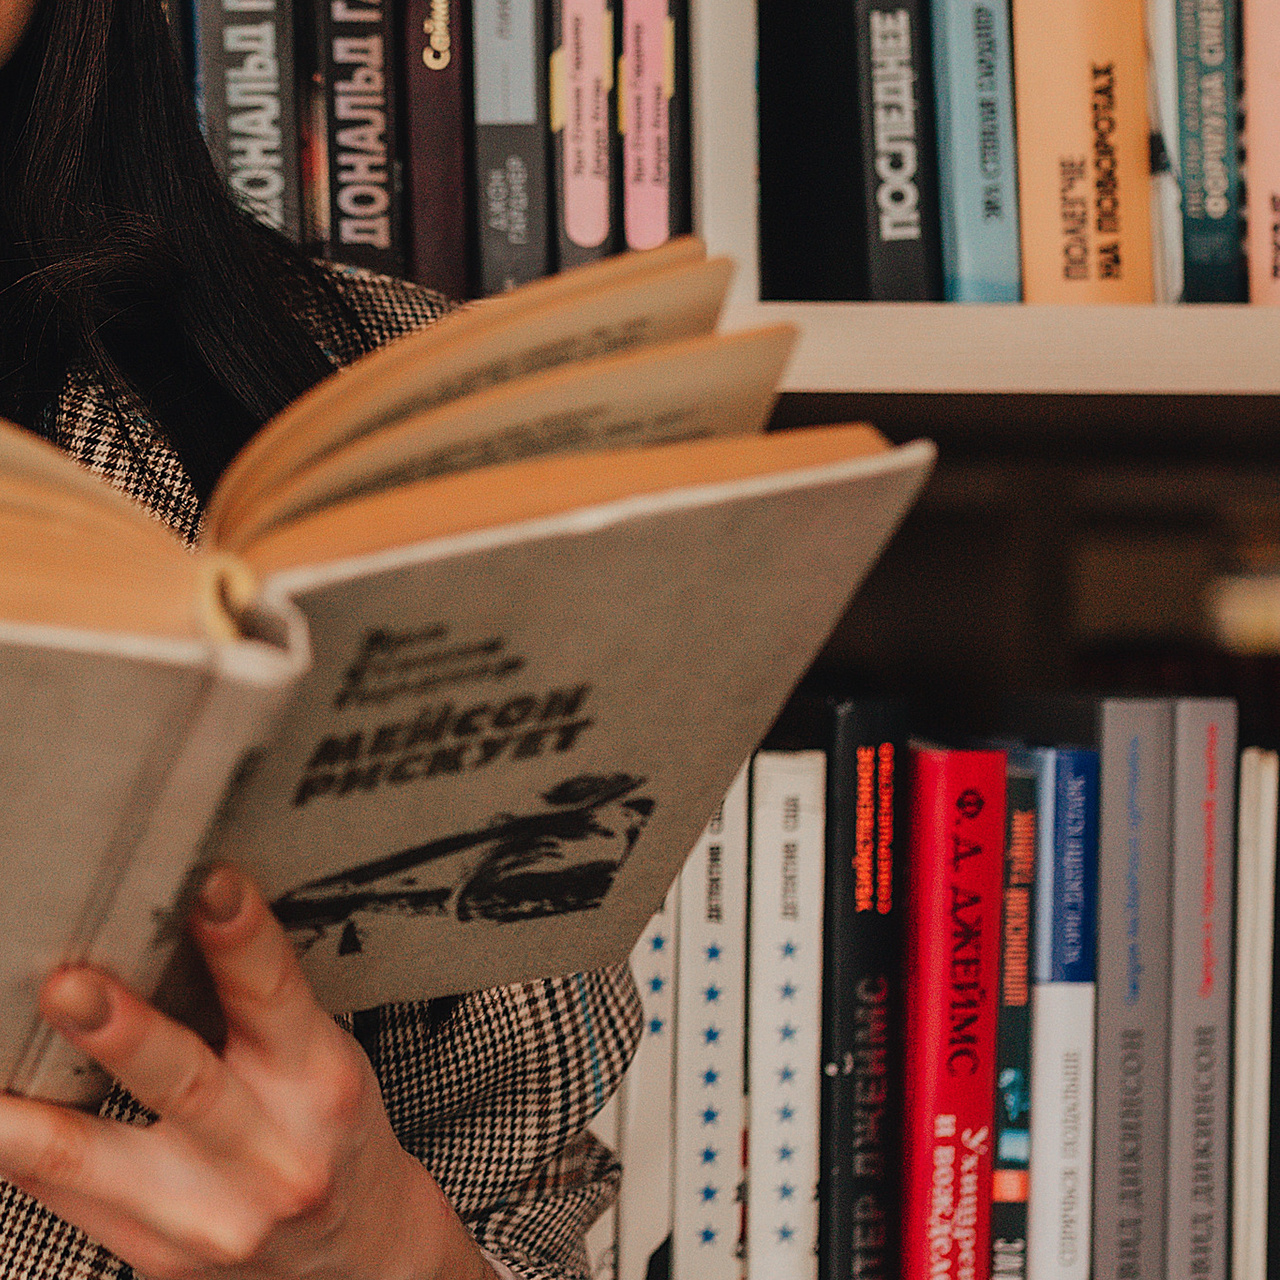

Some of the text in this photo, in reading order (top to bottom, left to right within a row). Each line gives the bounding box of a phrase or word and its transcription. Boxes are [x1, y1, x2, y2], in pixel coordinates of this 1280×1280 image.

[331, 36, 391, 249] ДОНАЛЬД
[870, 10, 920, 240] ПОСЛЕДНЕЕ
[1090, 62, 1121, 281] НА ПОВОРОТАХ
[1200, 72, 1229, 219] ФОРМУЛА
[1059, 157, 1089, 281] ПОЛЕГЧЕ
[292, 717, 596, 807] РИСКУЕТ
[308, 683, 593, 768] МЕЙСОН
[946, 884, 985, 1079] ДЖЕЙМС
[851, 974, 889, 1178] ДЖЕЙМС
[933, 1113, 957, 1137] и
[1118, 1027, 1145, 1209] ДИКИНСОН
[1191, 1026, 1219, 1204] ДИКИНСОН
